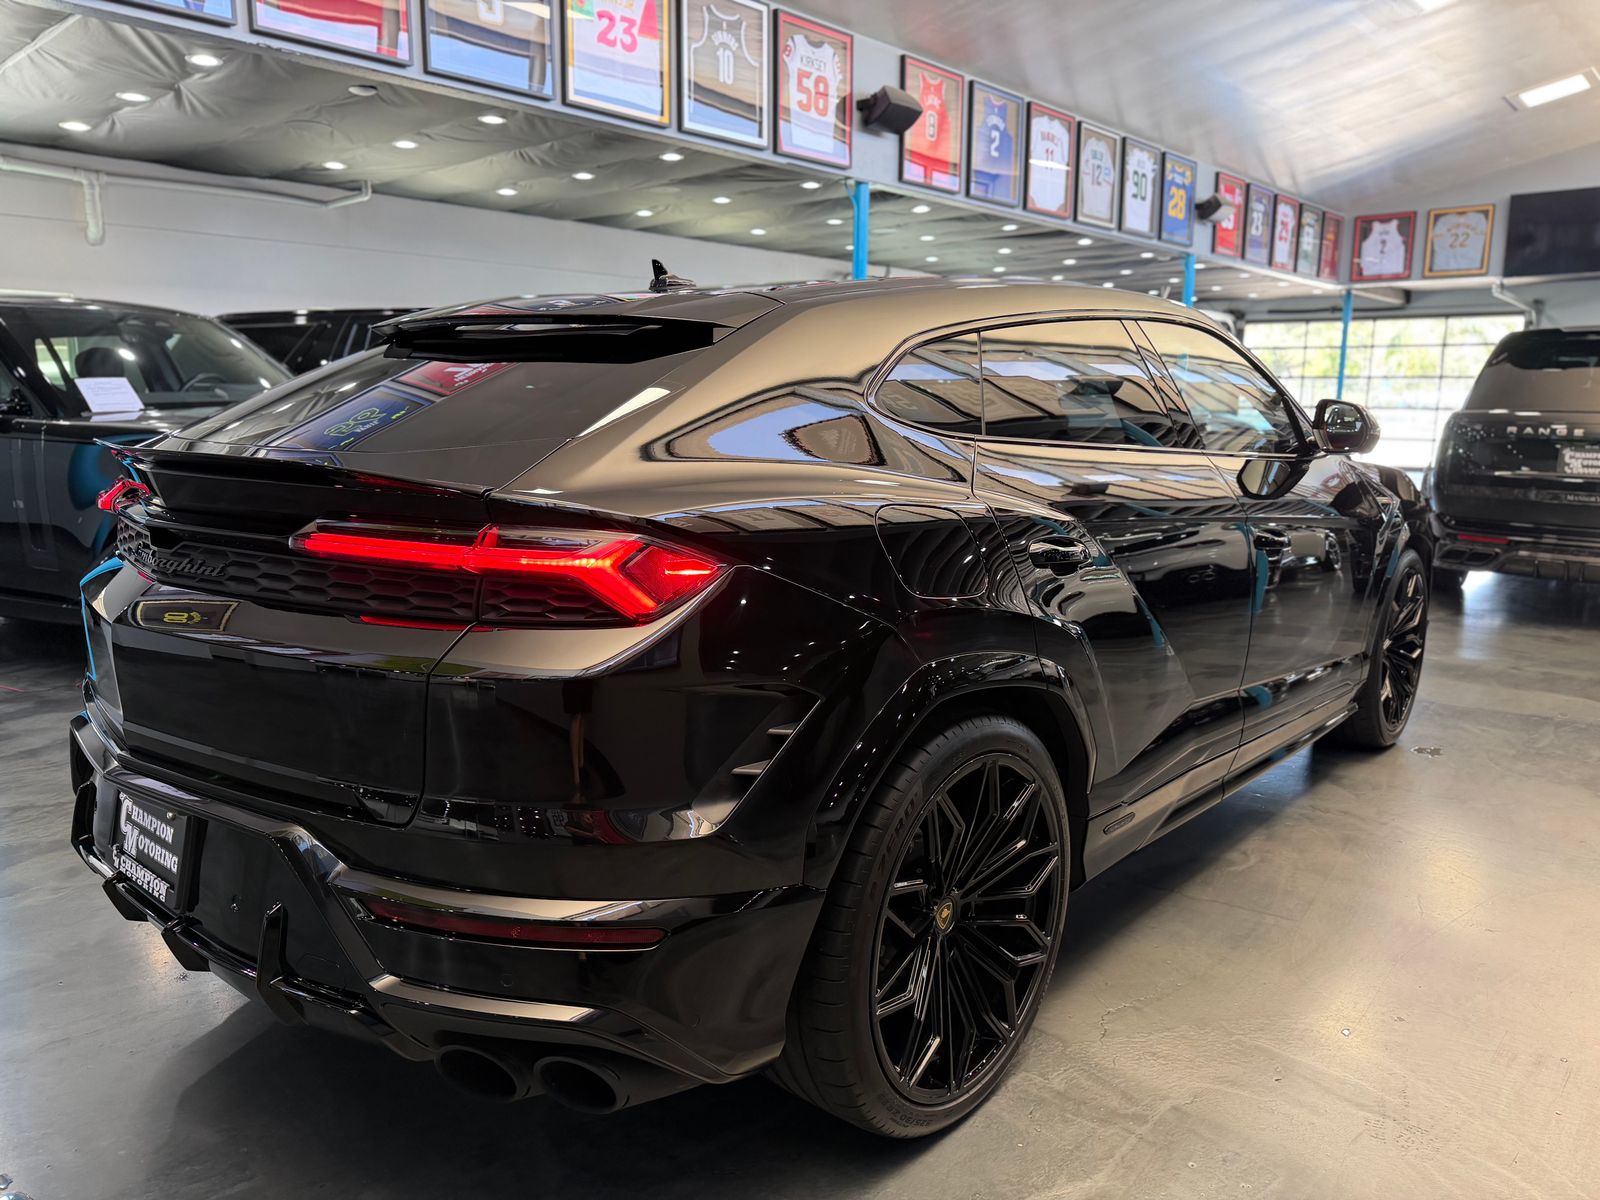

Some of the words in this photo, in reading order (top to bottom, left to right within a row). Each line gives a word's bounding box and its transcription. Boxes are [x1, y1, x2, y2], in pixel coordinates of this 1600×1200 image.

[596, 10, 637, 53] 23
[716, 48, 734, 85] 10
[796, 68, 829, 117] 58
[990, 130, 1000, 158] 2
[1091, 163, 1102, 187] 12
[1131, 169, 1148, 202] 90
[1449, 232, 1471, 248] 22
[1506, 425, 1585, 437] RANGE
[120, 792, 174, 845] CHAMPION
[123, 824, 178, 875] MOTORING
[120, 855, 168, 897] CHAMPION
